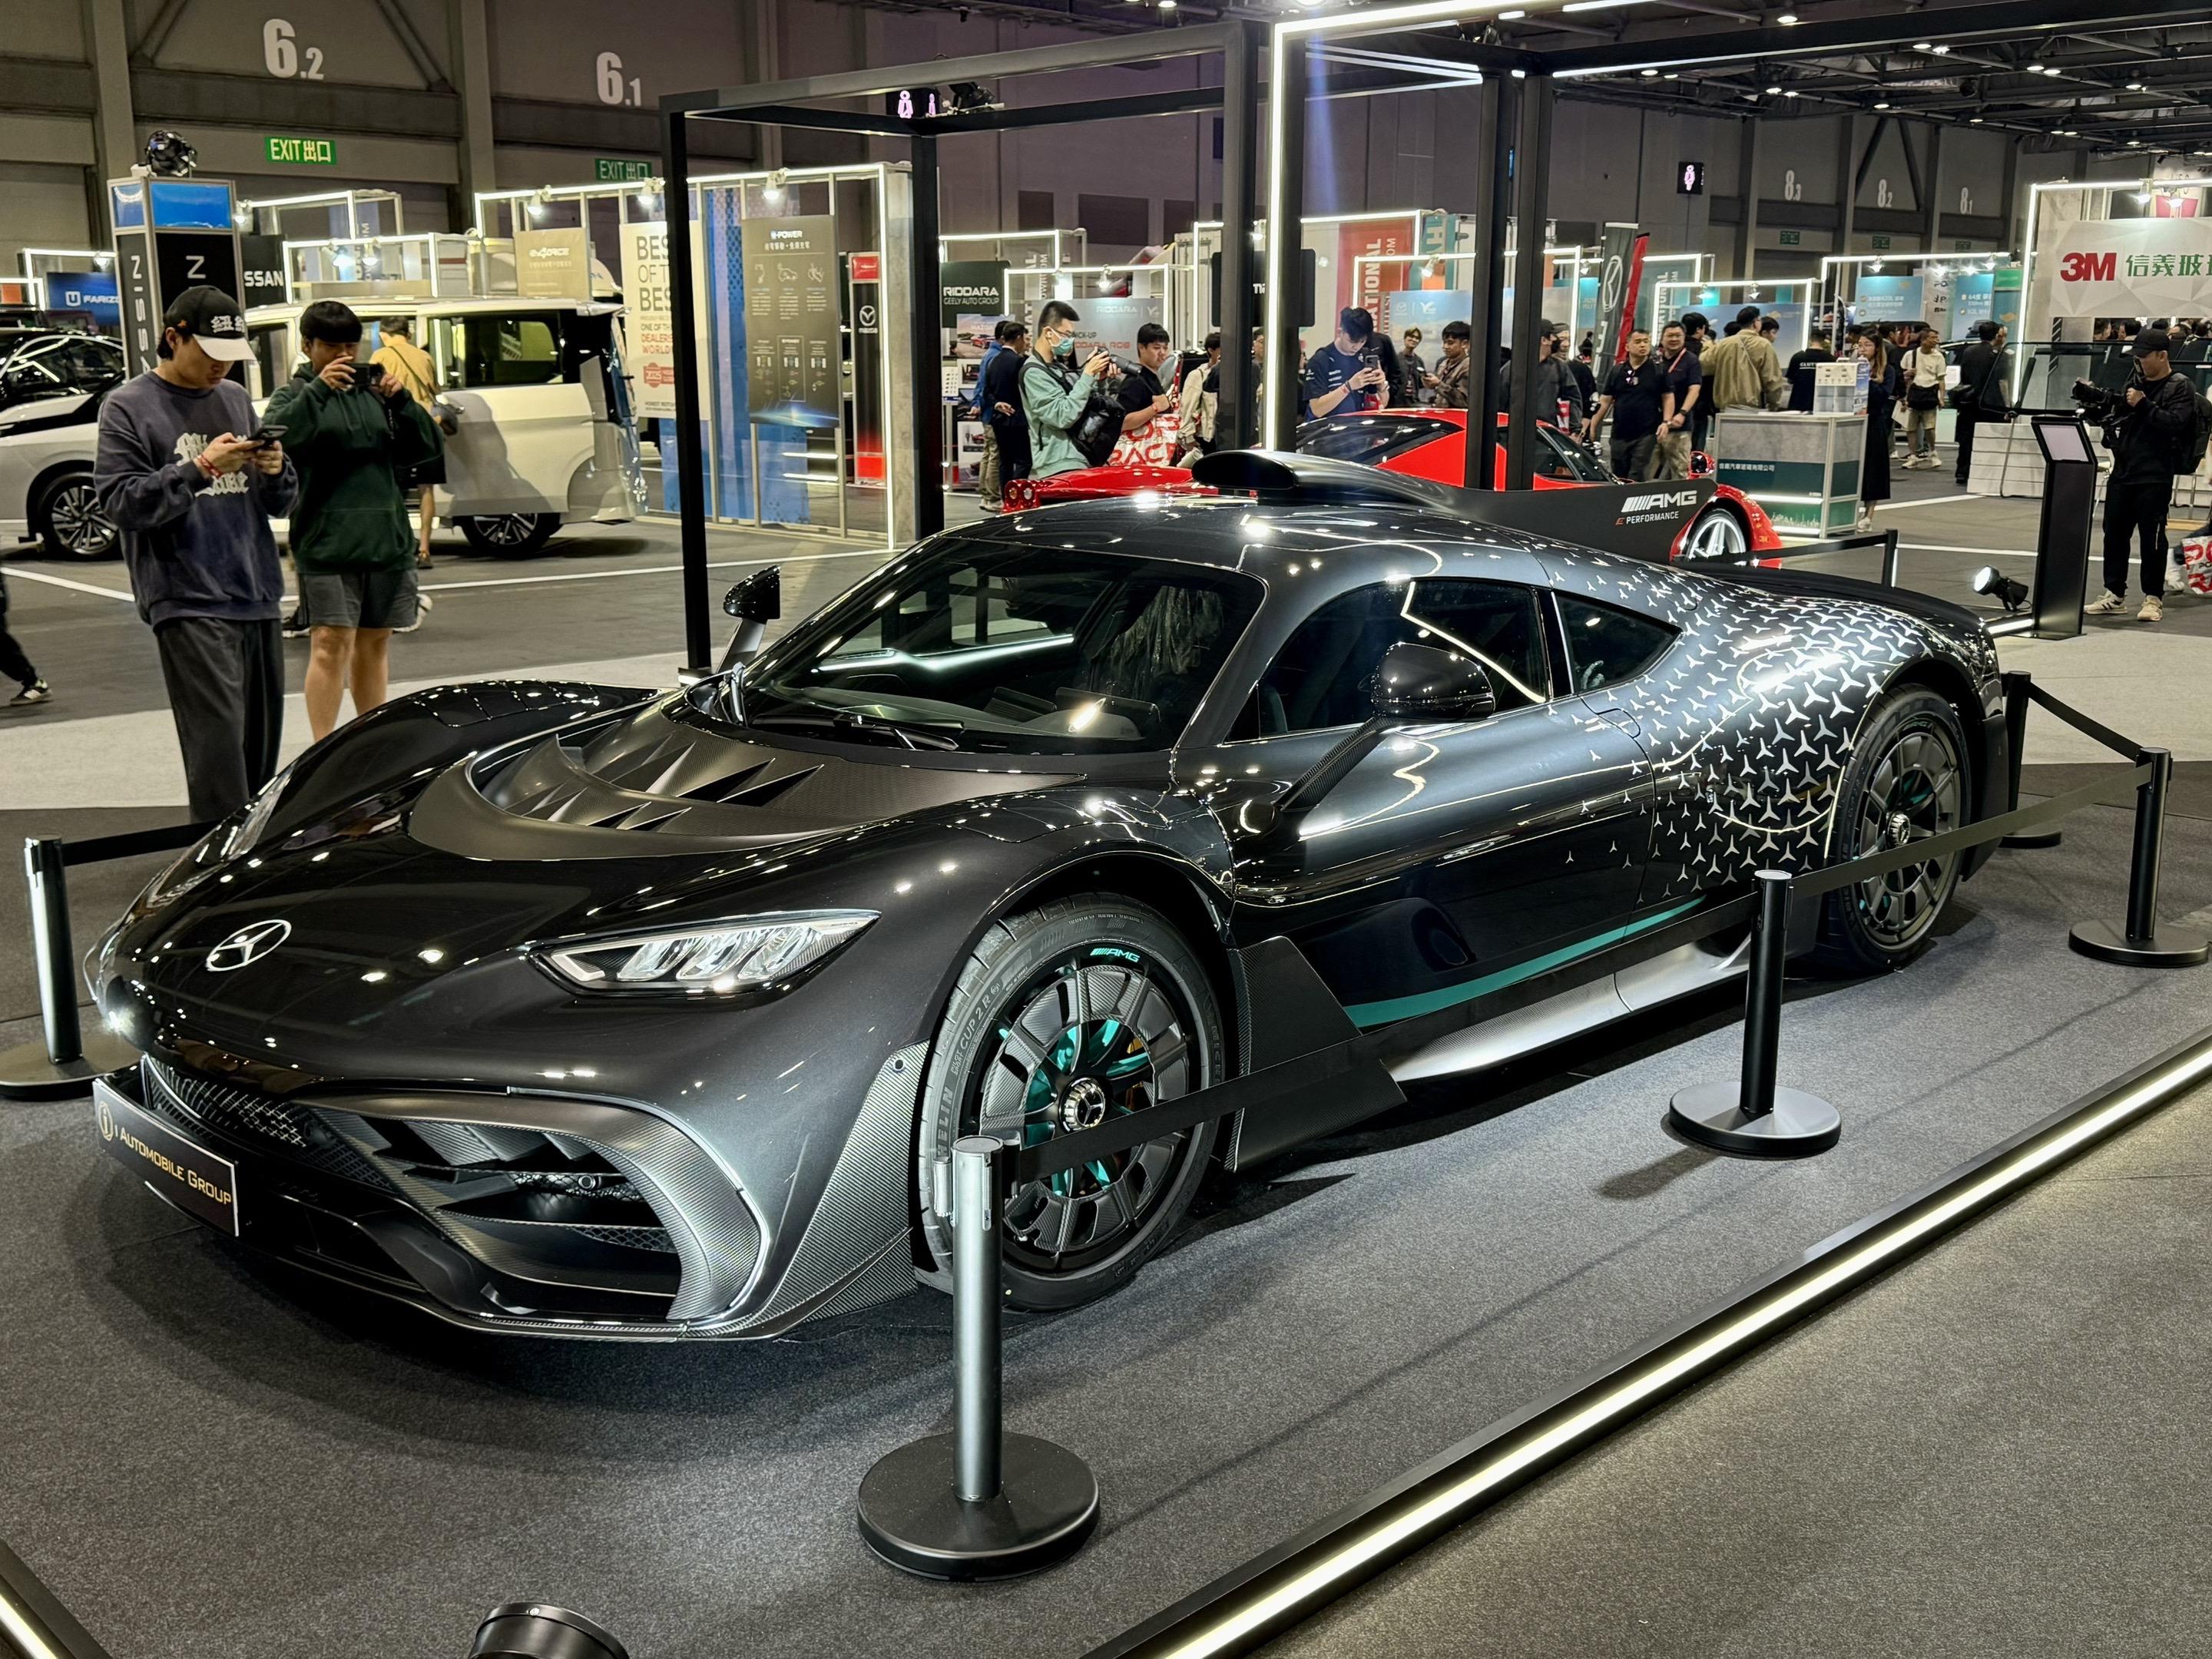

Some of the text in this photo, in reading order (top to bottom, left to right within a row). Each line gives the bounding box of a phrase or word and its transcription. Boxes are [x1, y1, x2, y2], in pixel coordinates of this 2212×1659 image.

[263, 18, 324, 80] 6.2
[597, 52, 641, 107] 6.1
[270, 138, 331, 162] EXIT 出口
[600, 161, 648, 180] EXIT 出口
[638, 265, 657, 283] OF
[2060, 252, 2118, 283] 3M
[943, 286, 999, 296] RIDDARA
[1643, 490, 1697, 511] AMG
[1626, 510, 1680, 525] PERFORMANCE
[1101, 947, 1141, 963] AMG
[960, 1018, 976, 1050] CUP
[975, 1007, 984, 1021] 2
[982, 994, 992, 1009] R
[120, 1126, 185, 1182] AUTOMOBILE
[187, 1169, 232, 1205] GROUP
